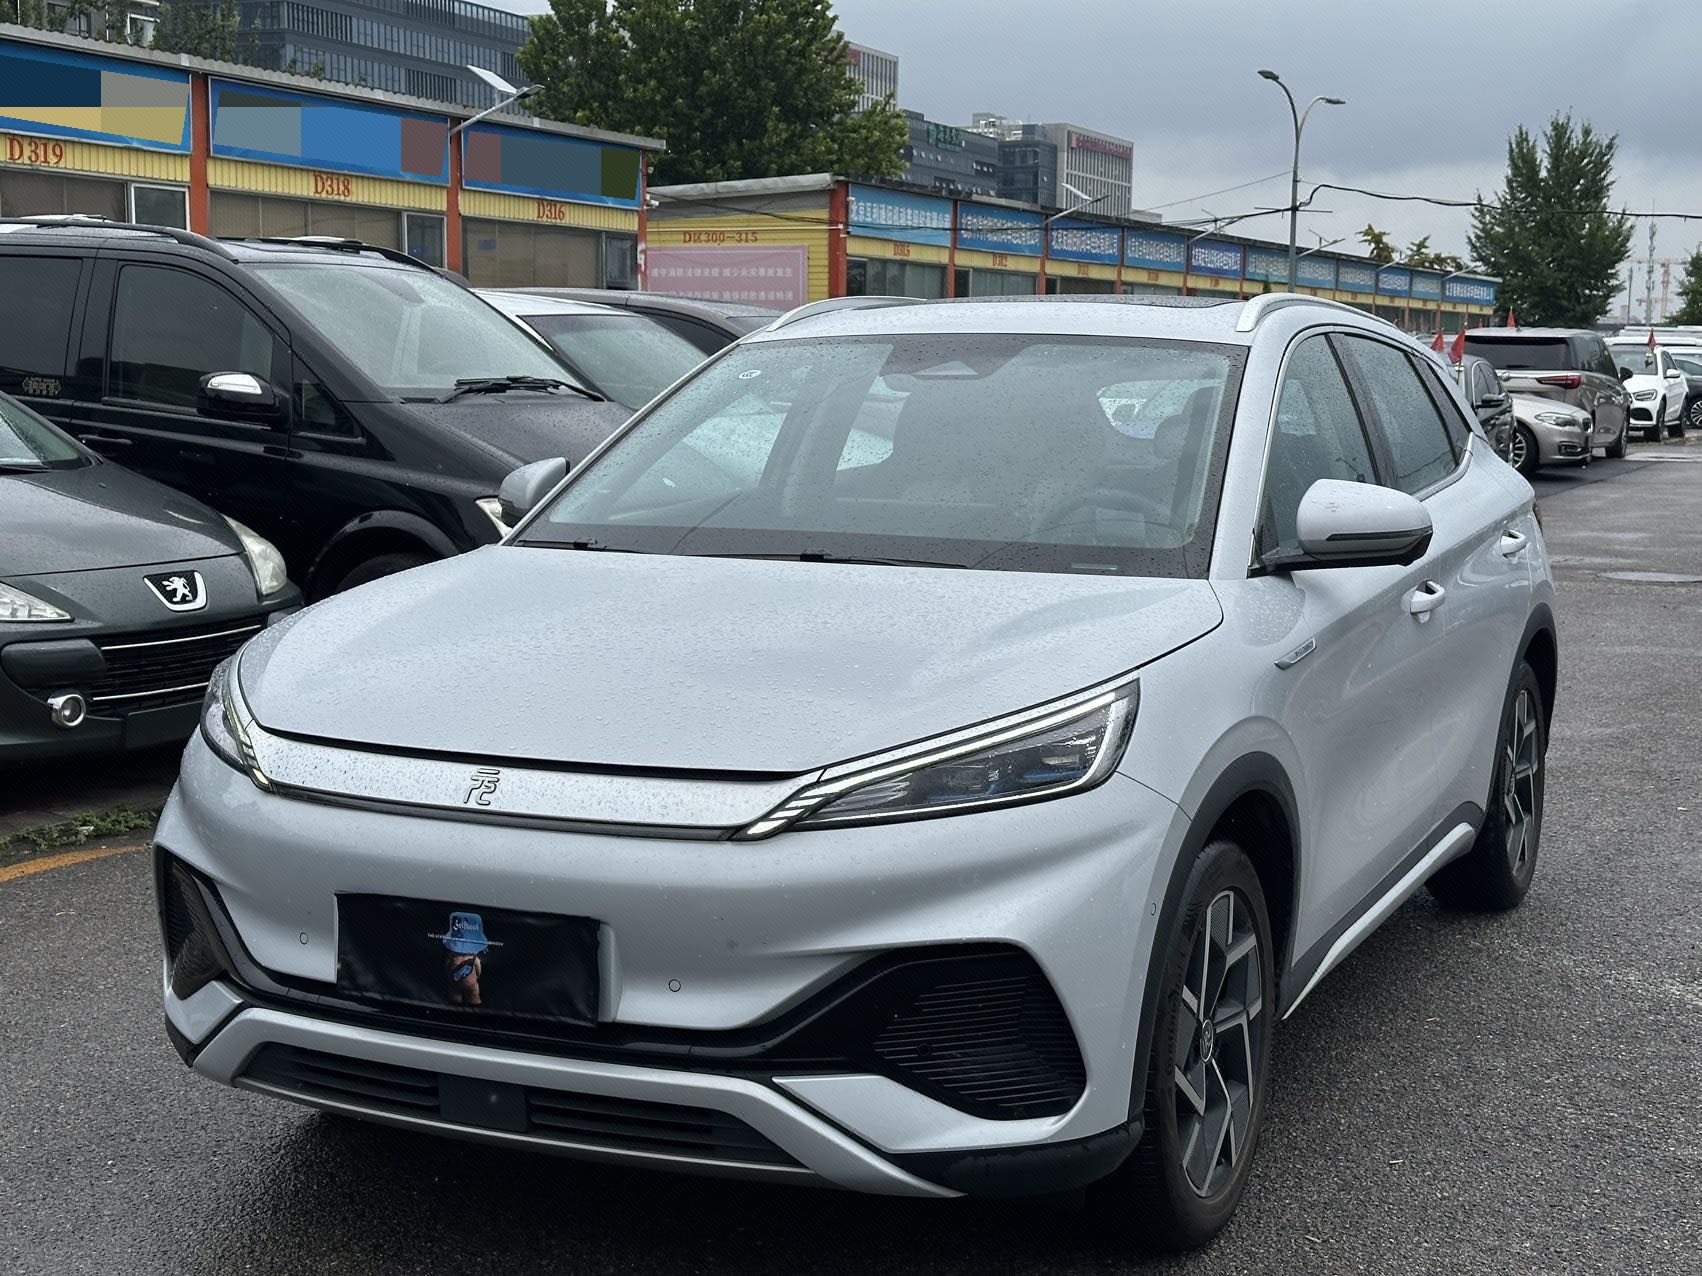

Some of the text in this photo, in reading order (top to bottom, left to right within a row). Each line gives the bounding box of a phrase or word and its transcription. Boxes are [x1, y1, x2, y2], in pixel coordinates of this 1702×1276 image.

[8, 138, 63, 164] D319
[314, 174, 351, 197] D318
[537, 201, 566, 221] D316
[463, 767, 500, 806] 元
